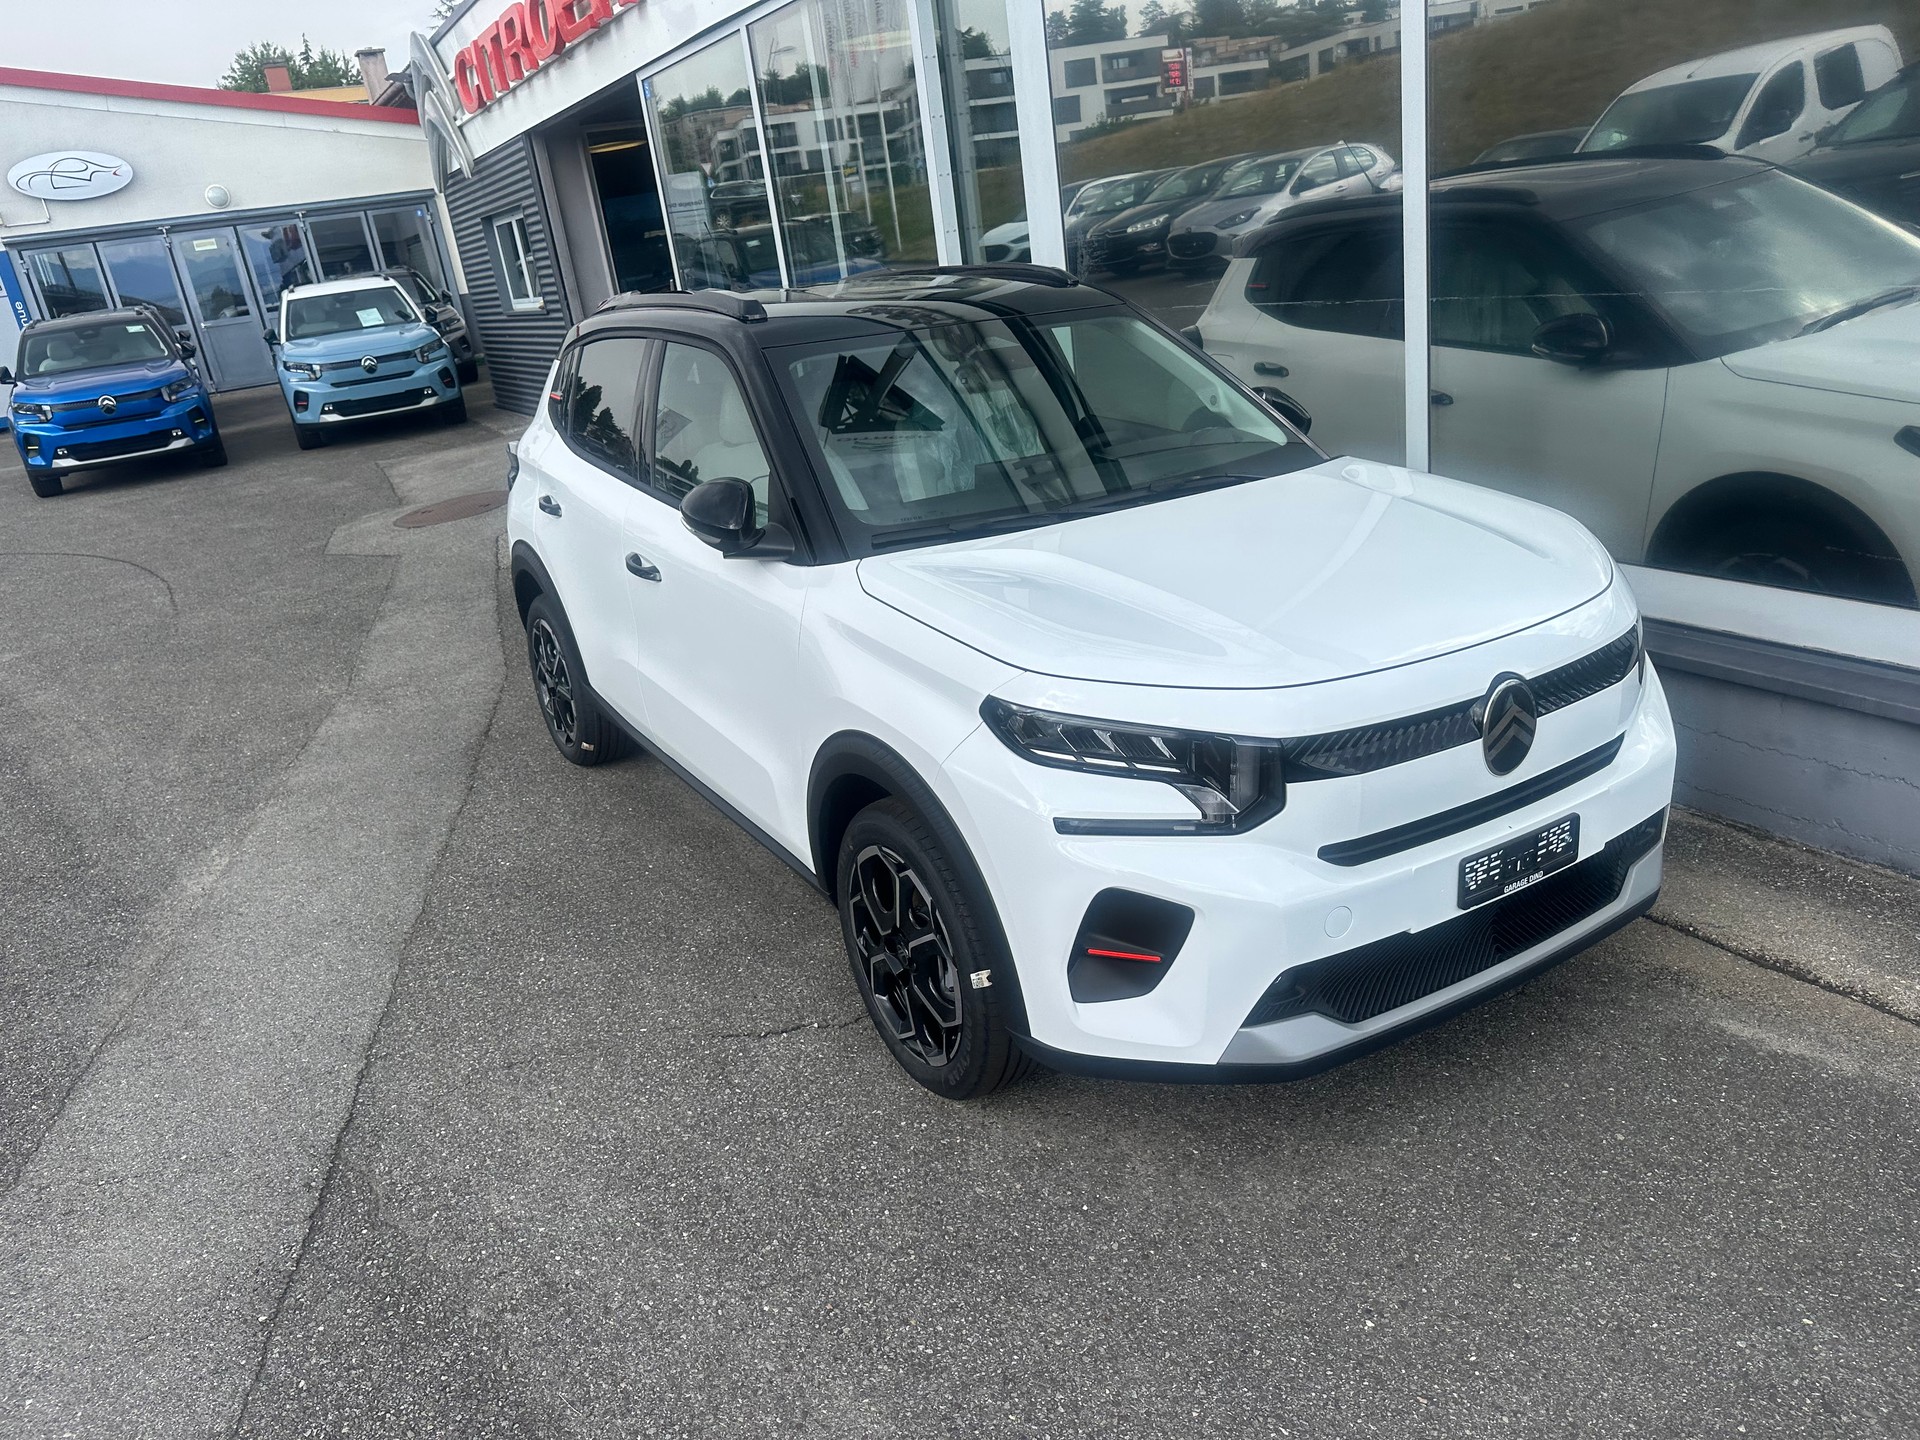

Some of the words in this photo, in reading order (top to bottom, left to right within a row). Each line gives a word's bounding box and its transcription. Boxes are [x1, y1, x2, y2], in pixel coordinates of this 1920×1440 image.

[454, 0, 638, 114] CITROE
[1503, 877, 1528, 893] GARAGE
[1529, 870, 1544, 883] DINO
